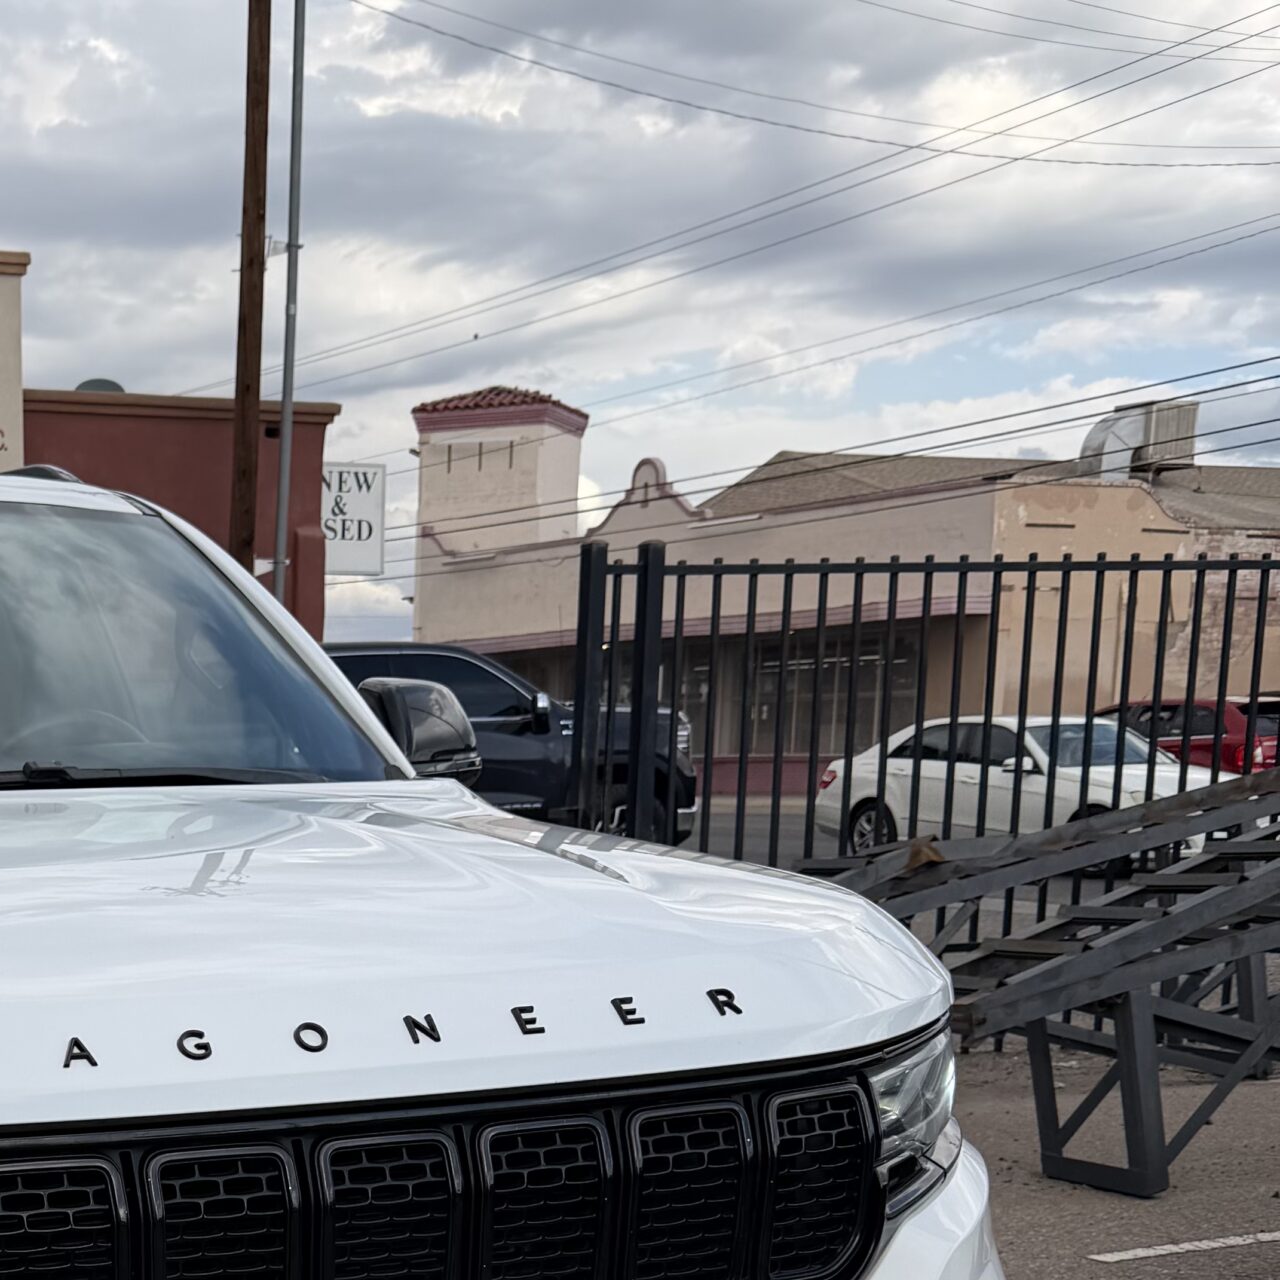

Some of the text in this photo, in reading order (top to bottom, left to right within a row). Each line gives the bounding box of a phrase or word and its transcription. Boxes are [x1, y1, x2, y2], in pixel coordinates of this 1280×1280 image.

[322, 471, 377, 493] NEW
[331, 495, 347, 517] &
[324, 519, 372, 541] SED
